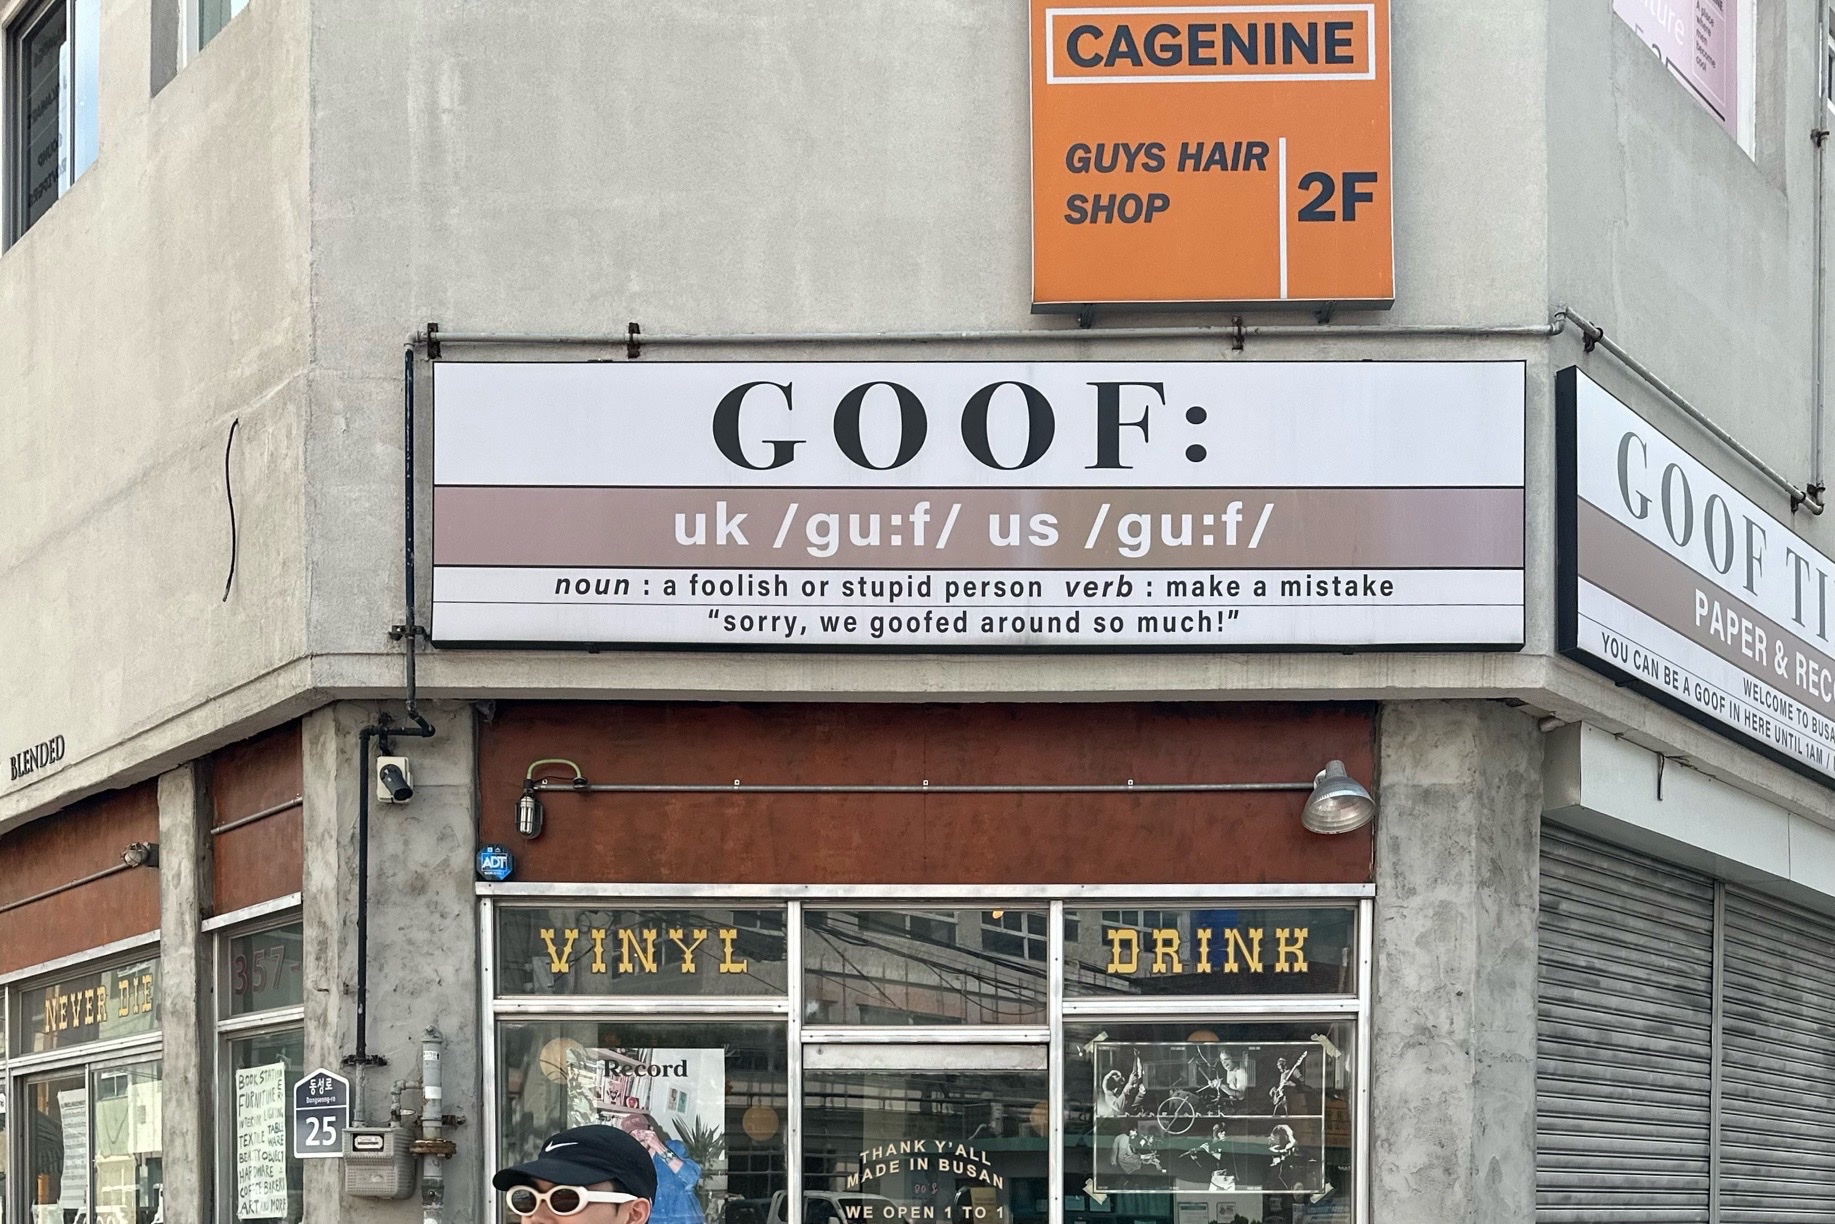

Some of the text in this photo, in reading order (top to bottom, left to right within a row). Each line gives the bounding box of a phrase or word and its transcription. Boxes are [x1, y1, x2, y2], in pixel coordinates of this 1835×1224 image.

[1066, 21, 1354, 67] CAGENINE
[1065, 141, 1270, 173] GUYS HAIR
[1064, 193, 1170, 224] SHOP
[1297, 171, 1378, 222] 2F
[712, 380, 1208, 470] GOOF:
[674, 501, 1275, 558] uk /gu:f/ us /gu:f/
[1617, 431, 1835, 648] GOOF TI
[554, 576, 630, 596] noun
[663, 578, 677, 597] a
[689, 574, 788, 598] foolish
[801, 579, 829, 598] or
[841, 575, 932, 602] stupid
[945, 579, 1043, 602] person
[1065, 574, 1133, 598] verb
[1166, 574, 1241, 598] make
[1253, 579, 1267, 598] a
[1280, 574, 1394, 598] mistake
[820, 614, 857, 632] we
[870, 609, 968, 638] goofed
[980, 610, 1081, 633] around
[1093, 615, 1124, 633] so
[1695, 588, 1835, 703] PAPER & REC
[1601, 631, 1628, 664] YOU
[1633, 649, 1659, 680] CAN
[1664, 665, 1679, 690] BE
[1683, 676, 1690, 696] A
[1694, 682, 1726, 714] GOOF
[1729, 700, 1740, 723] IN
[1744, 708, 1770, 739] HERE
[1775, 727, 1802, 755] UNTIL
[1806, 743, 1823, 765] 1AM
[1743, 677, 1835, 742] WELCOME TO BUSA
[10, 734, 65, 781] BLENDED
[481, 855, 507, 869] ADT
[540, 928, 748, 974] VINYL
[1106, 928, 1309, 974] DRINK
[45, 974, 152, 1033] NEVER DIE
[309, 1078, 333, 1095] 동성로
[603, 1059, 688, 1078] Record
[305, 1116, 337, 1146] 25
[860, 1140, 927, 1165] THANK
[846, 1158, 1004, 1190] MADE IN BUSAN
[846, 1206, 1004, 1219] WE OPEN 1 TO 1
